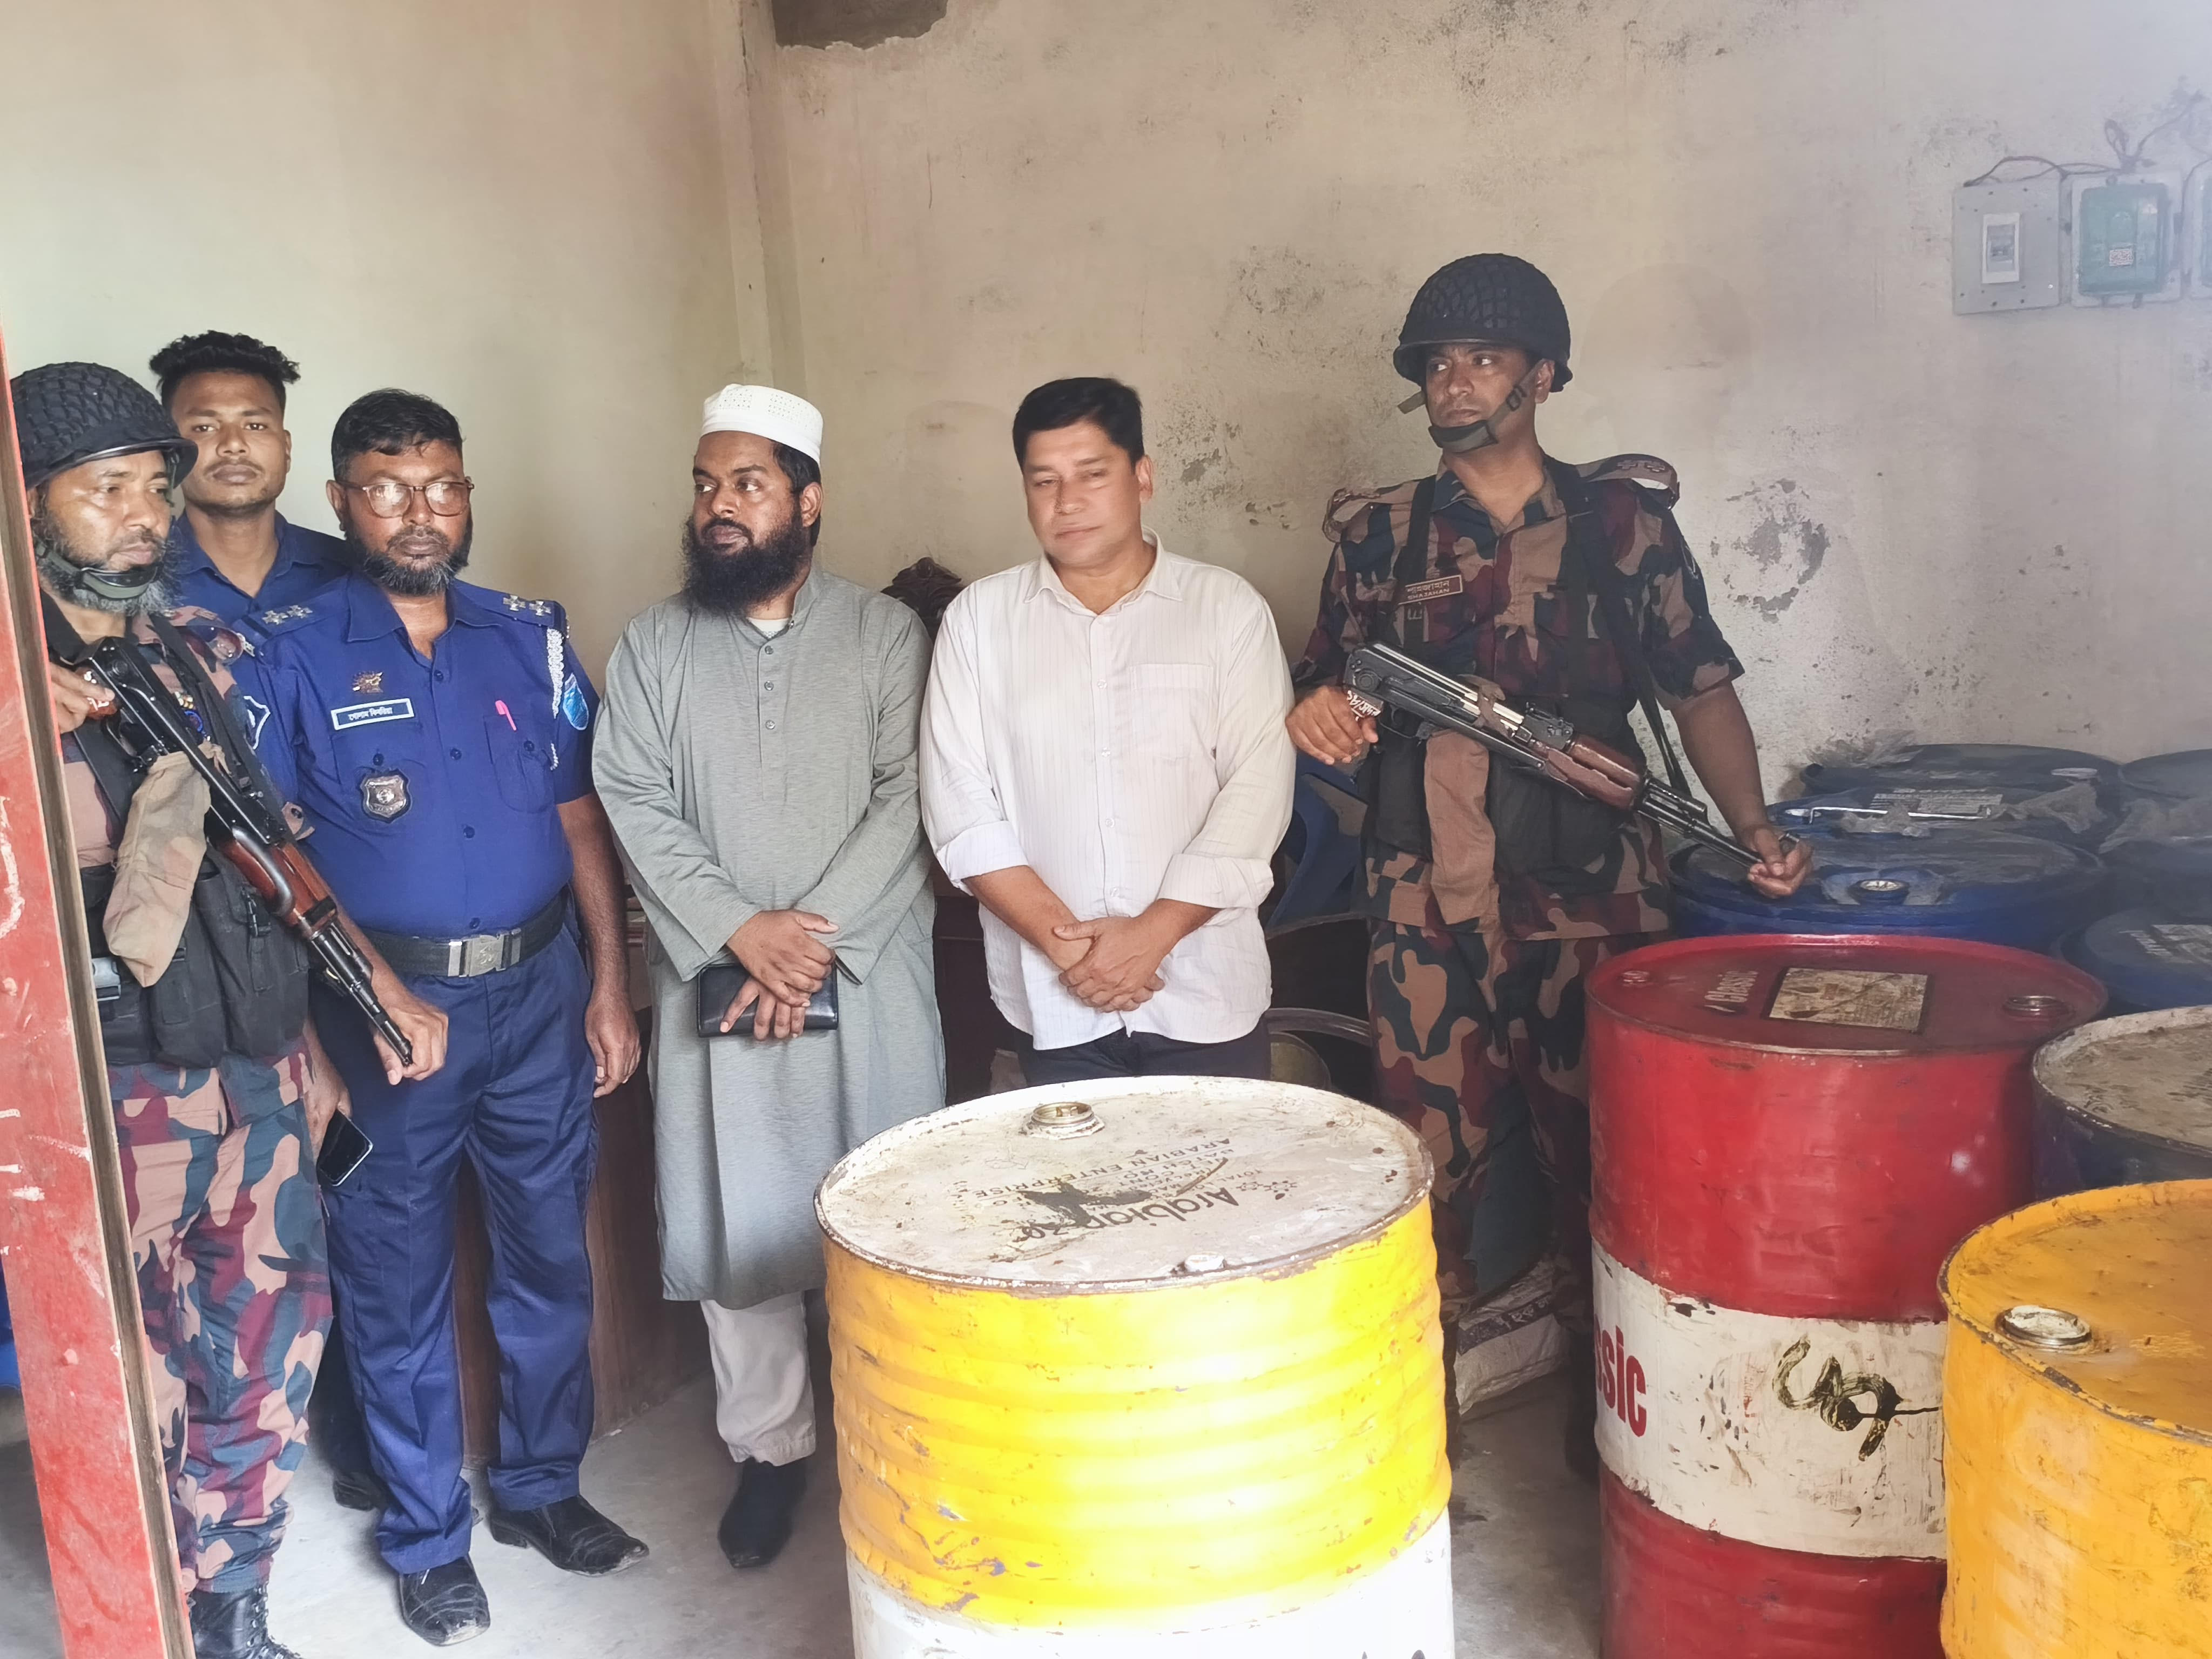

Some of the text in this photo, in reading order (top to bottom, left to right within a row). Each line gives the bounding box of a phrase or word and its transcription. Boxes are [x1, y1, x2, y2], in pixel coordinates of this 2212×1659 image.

[1407, 588, 1449, 600] SHAJAHAN
[1705, 972, 1758, 1003] Classic
[974, 1138, 1230, 1199] ARABIAN ENTERPRISE
[1216, 1169, 1263, 1182] TOTAL
[1080, 1187, 1239, 1230] Arabian
